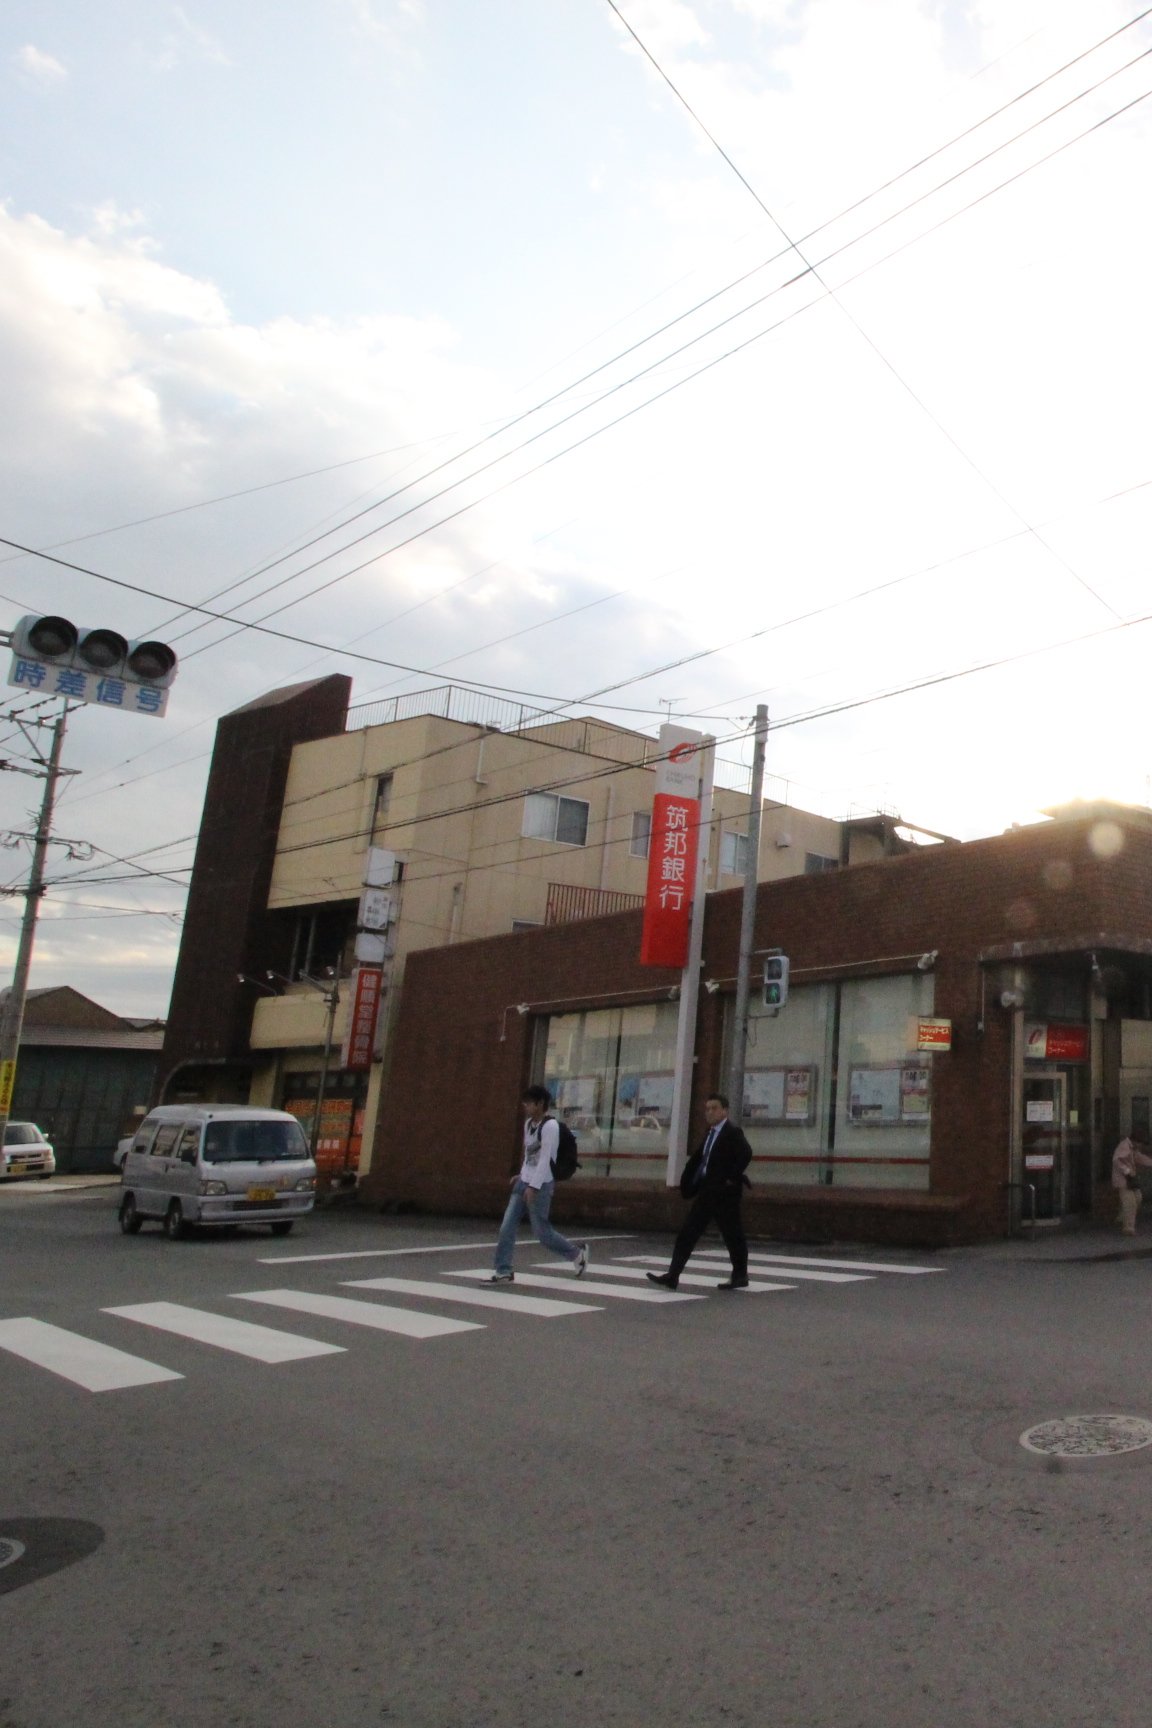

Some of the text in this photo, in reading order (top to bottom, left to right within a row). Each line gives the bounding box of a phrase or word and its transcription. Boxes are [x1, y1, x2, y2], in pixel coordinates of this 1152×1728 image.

[13, 659, 163, 714] 時差信号
[658, 804, 689, 911] 筑邦銀行
